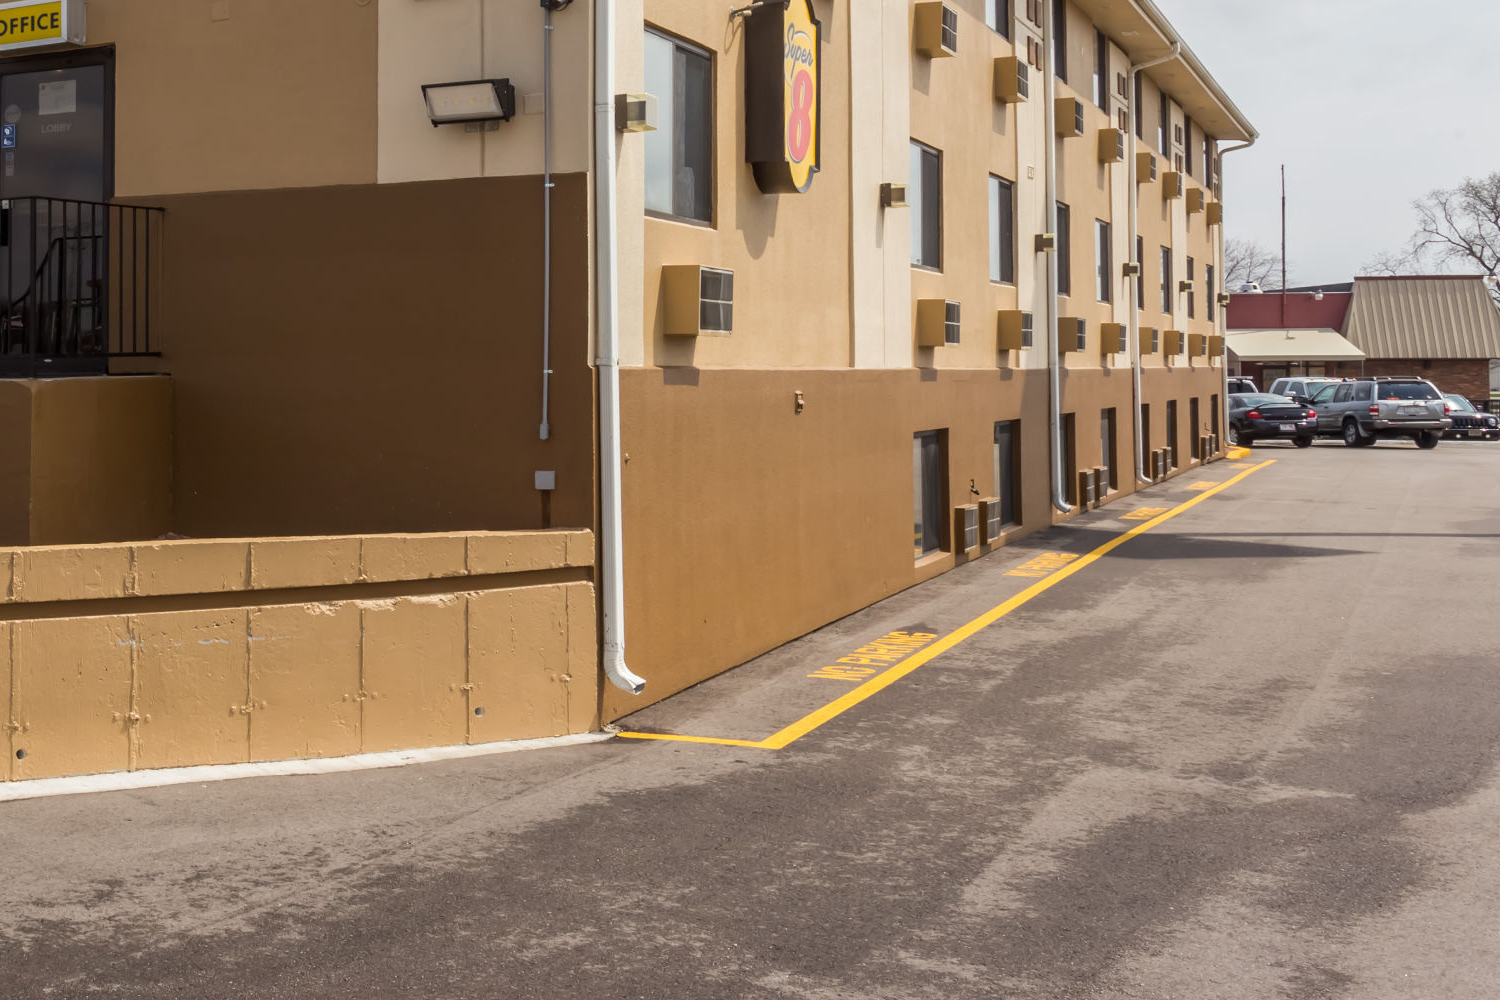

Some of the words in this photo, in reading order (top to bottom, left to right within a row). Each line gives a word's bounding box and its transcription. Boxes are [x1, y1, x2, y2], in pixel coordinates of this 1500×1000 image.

[784, 22, 814, 80] Super
[41, 123, 72, 133] LOBBY
[787, 69, 814, 164] 8
[835, 631, 938, 666] PARKING
[806, 665, 876, 681] NO
